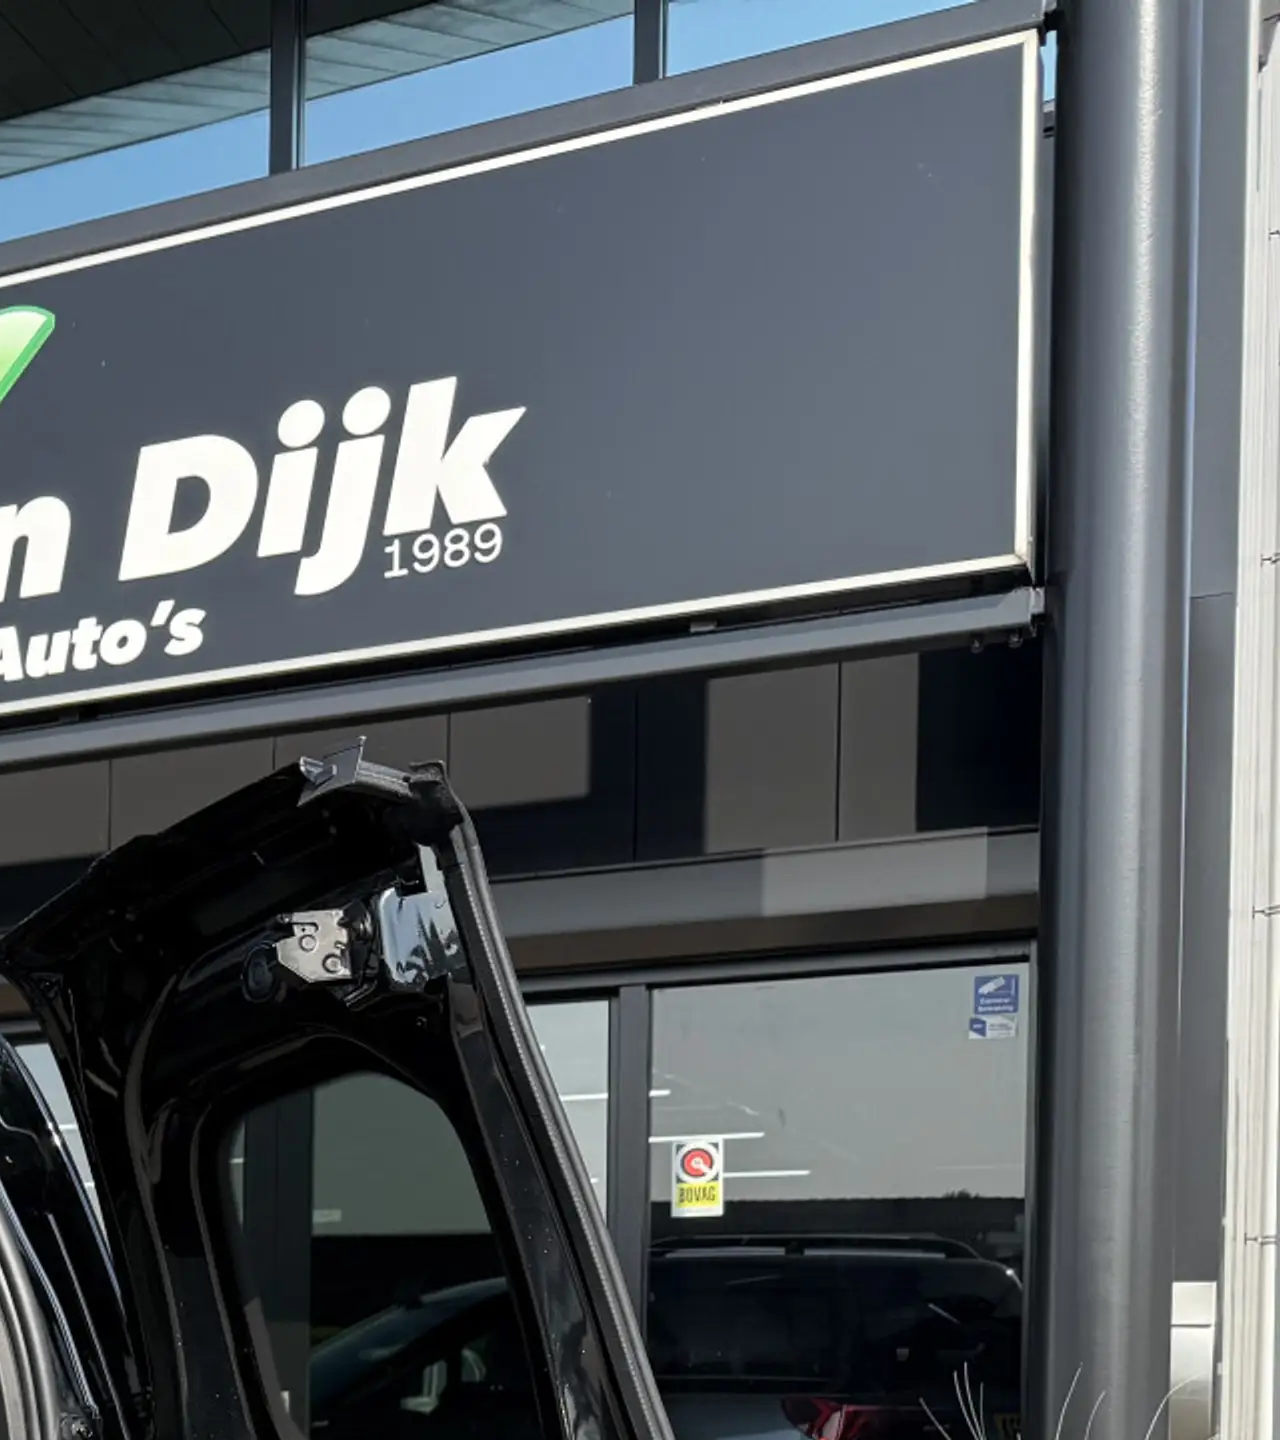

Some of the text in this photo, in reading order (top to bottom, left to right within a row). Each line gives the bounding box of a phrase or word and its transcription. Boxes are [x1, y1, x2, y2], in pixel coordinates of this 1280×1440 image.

[117, 375, 527, 595] Dijk
[383, 522, 503, 578] 1989
[679, 1186, 716, 1203] BOVAG
